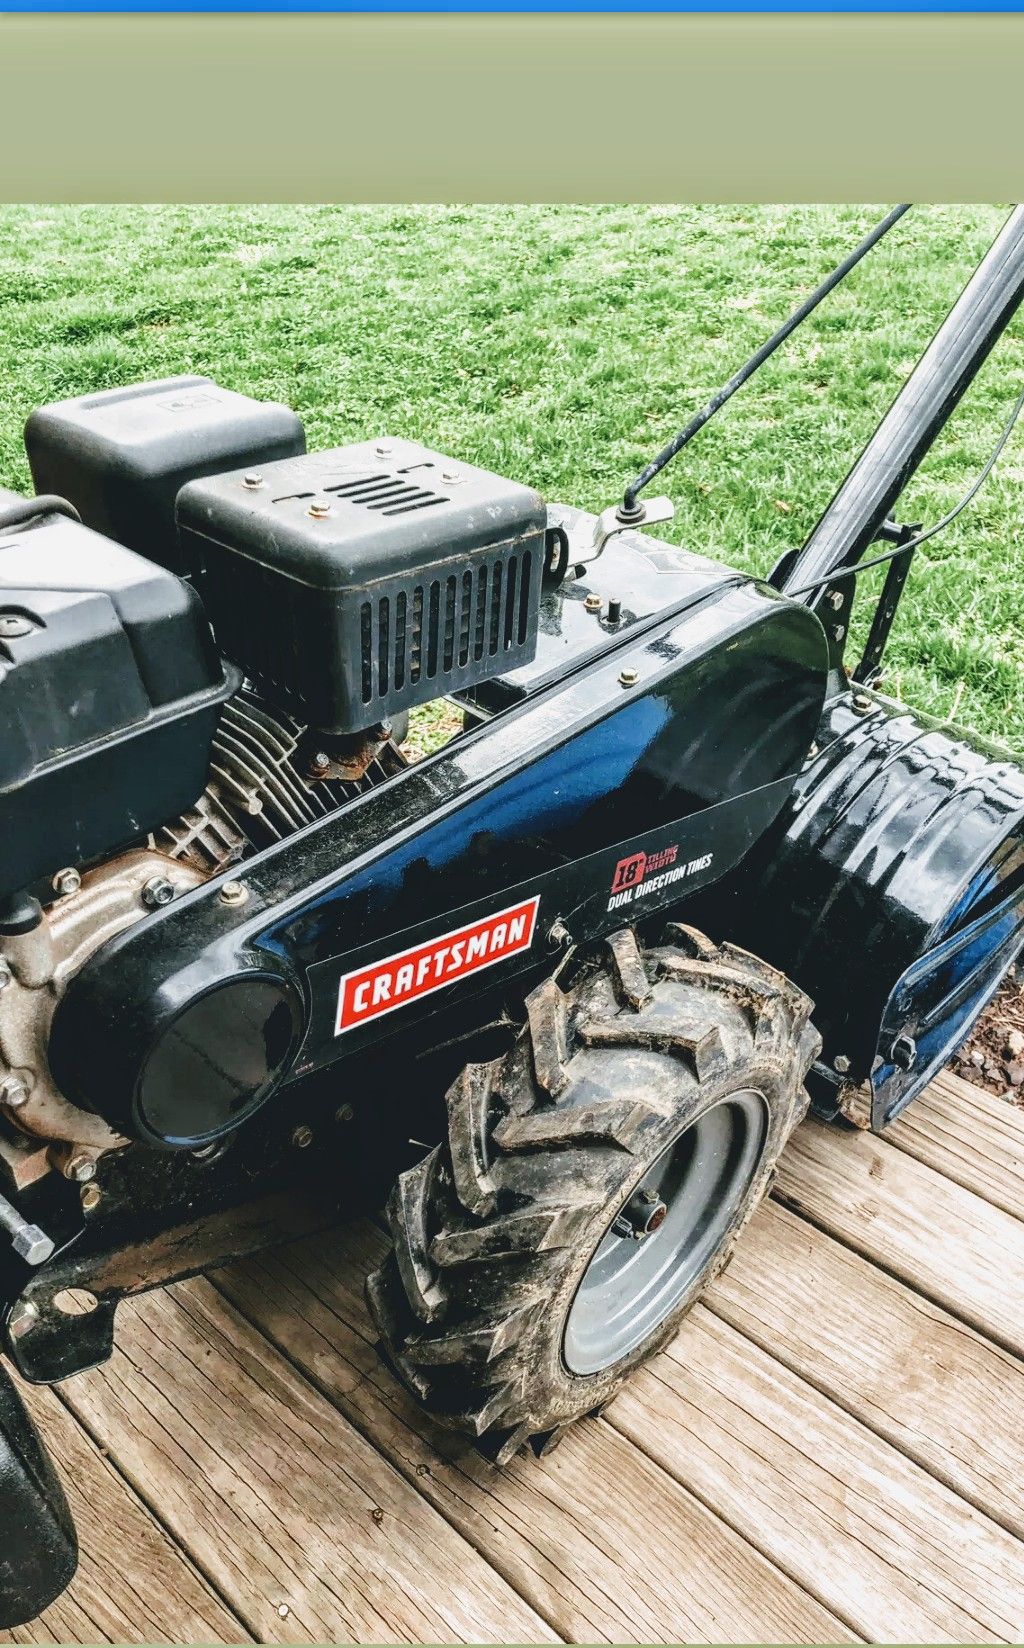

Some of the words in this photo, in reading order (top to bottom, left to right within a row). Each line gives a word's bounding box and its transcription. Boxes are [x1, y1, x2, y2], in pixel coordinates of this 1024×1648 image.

[607, 888, 633, 912] DUAL
[634, 864, 686, 899] DIRECTION
[686, 853, 713, 876] TINES
[648, 844, 679, 864] TILLING
[353, 914, 527, 1013] CRAFTSMAN
